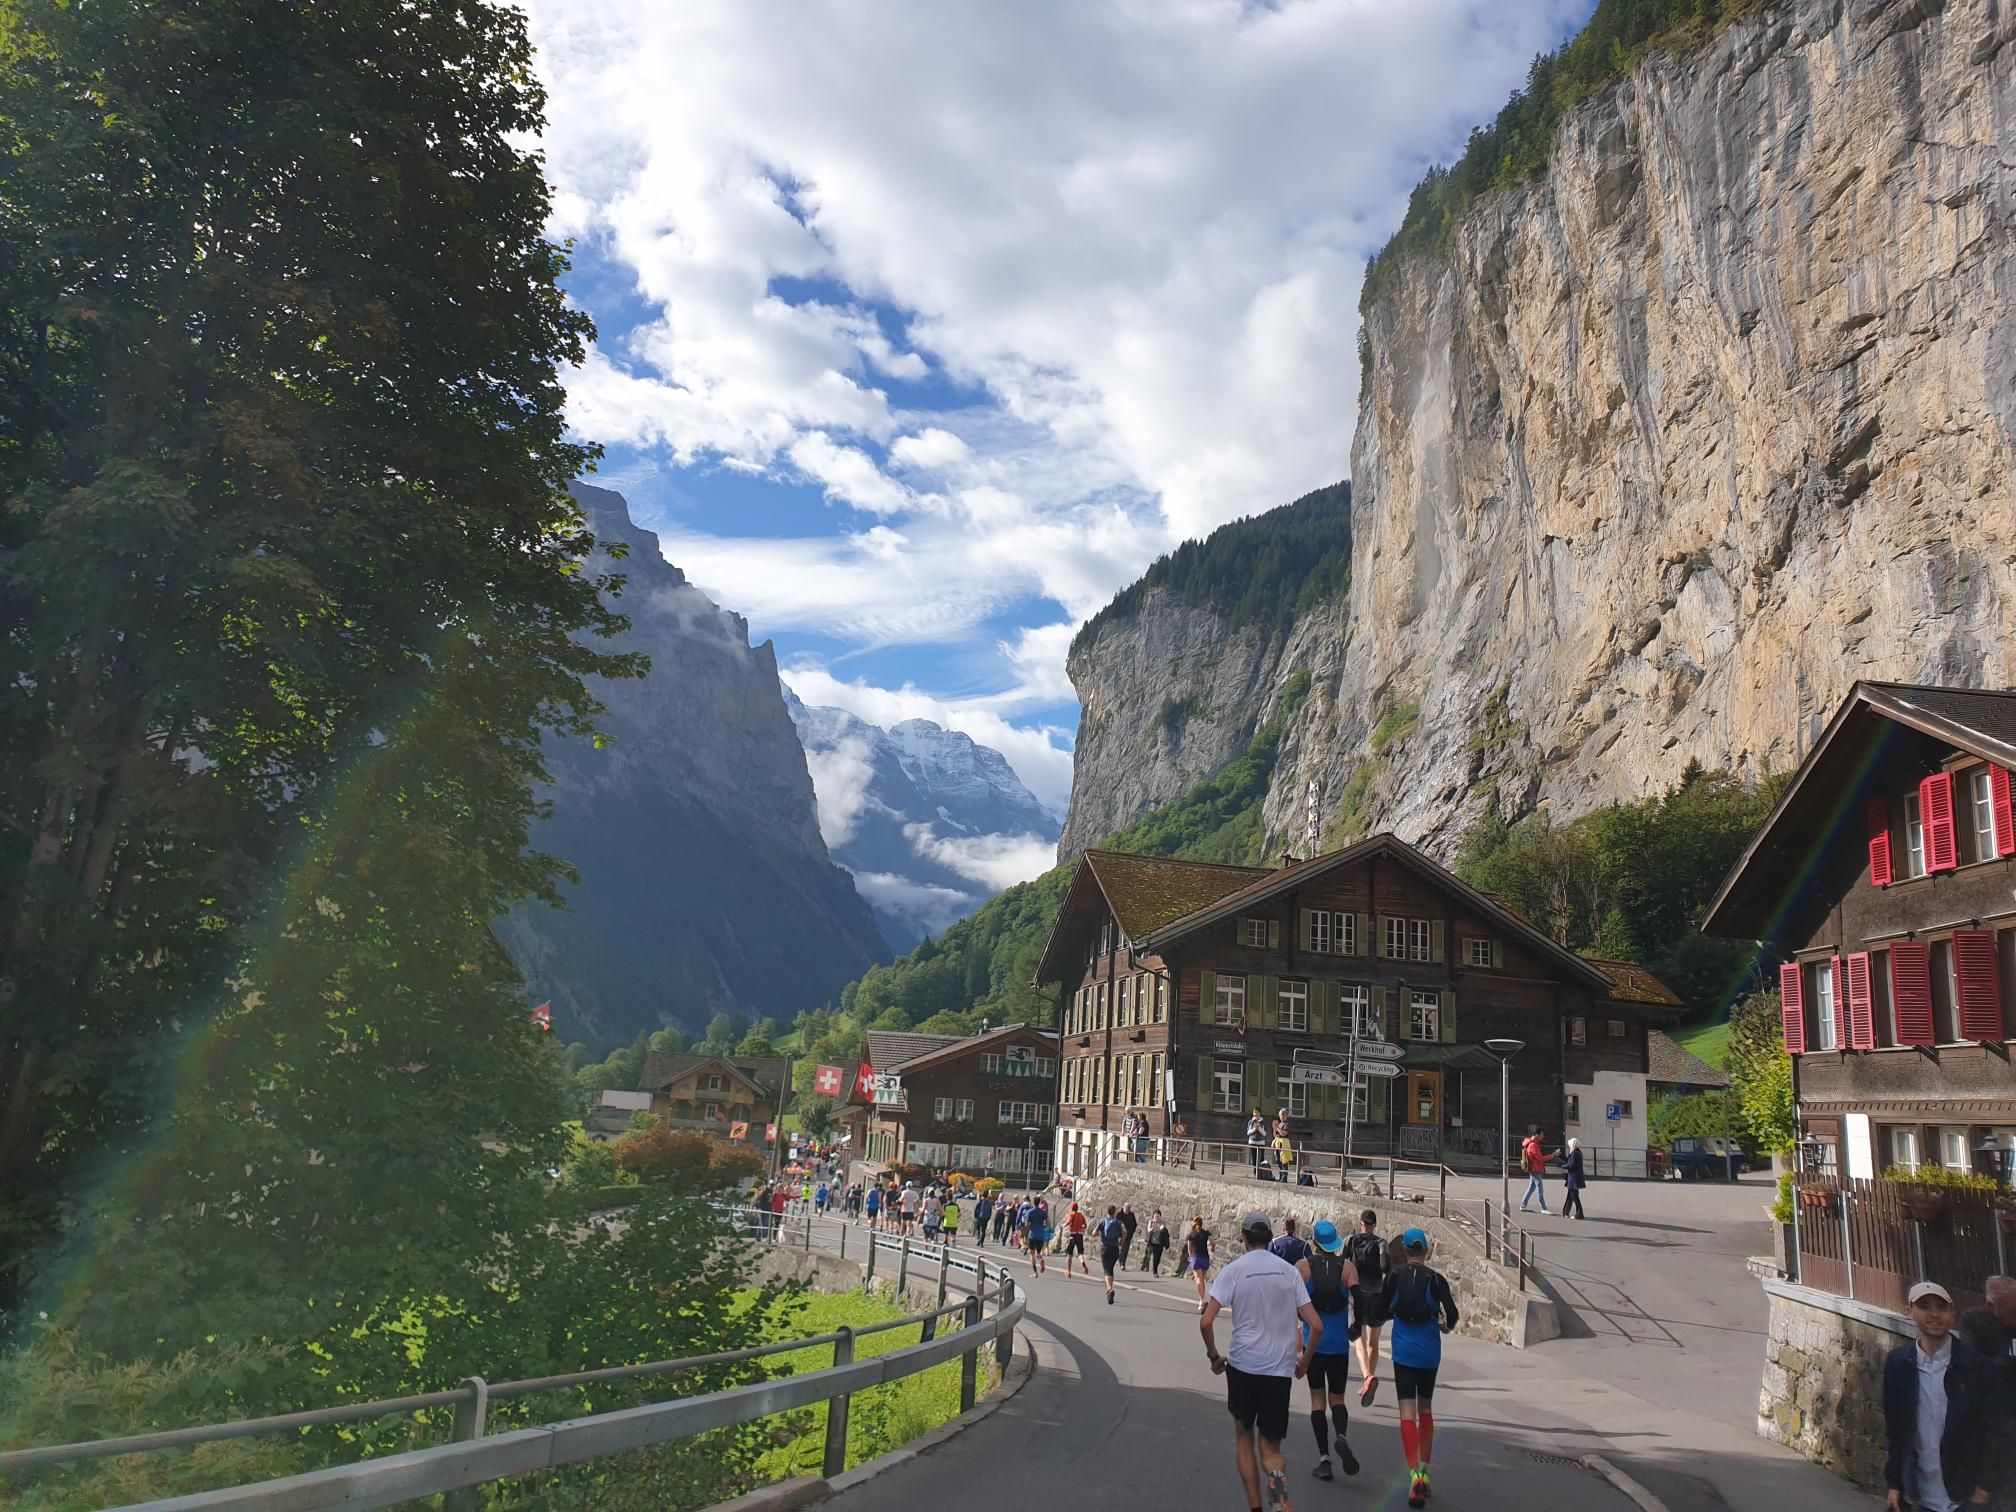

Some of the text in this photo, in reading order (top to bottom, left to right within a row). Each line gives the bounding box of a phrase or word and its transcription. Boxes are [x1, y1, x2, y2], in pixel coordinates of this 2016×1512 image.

[1360, 1043, 1385, 1054] Werkhof
[1368, 1064, 1394, 1074] Recycling
[1304, 1070, 1323, 1080] Arzt
[1608, 1106, 1615, 1116] P
